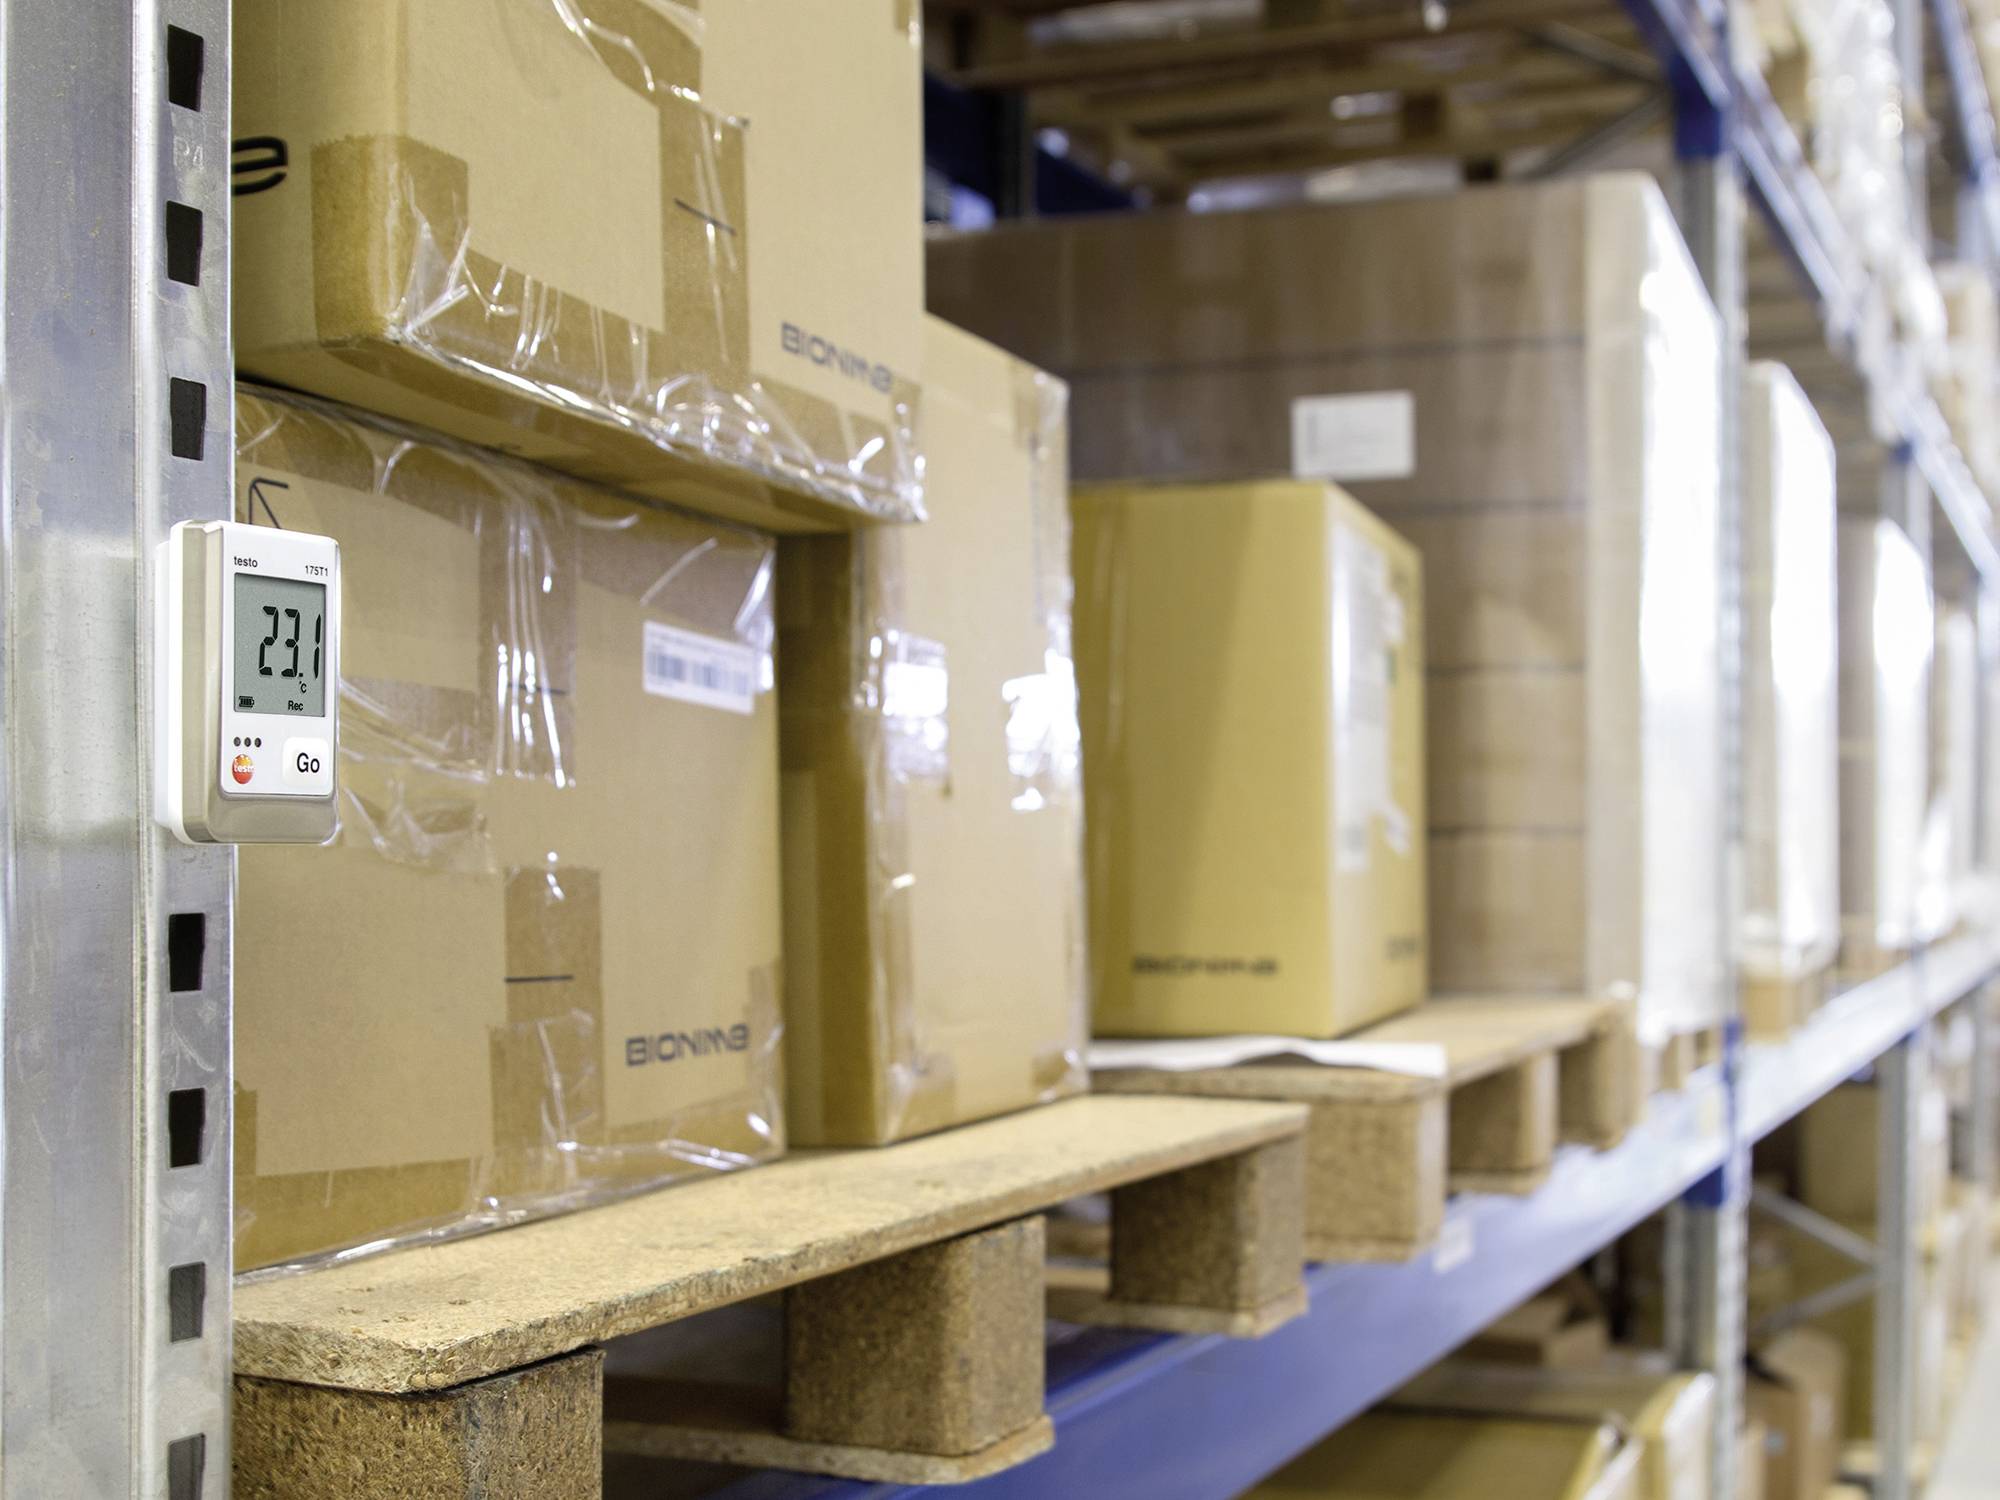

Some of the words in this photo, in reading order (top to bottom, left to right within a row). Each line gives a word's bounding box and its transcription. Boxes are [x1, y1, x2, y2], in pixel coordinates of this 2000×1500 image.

[233, 555, 259, 569] testo
[304, 564, 329, 578] 175T1
[258, 605, 322, 680] 23.1
[287, 700, 304, 712] Rec
[296, 752, 321, 774] Go
